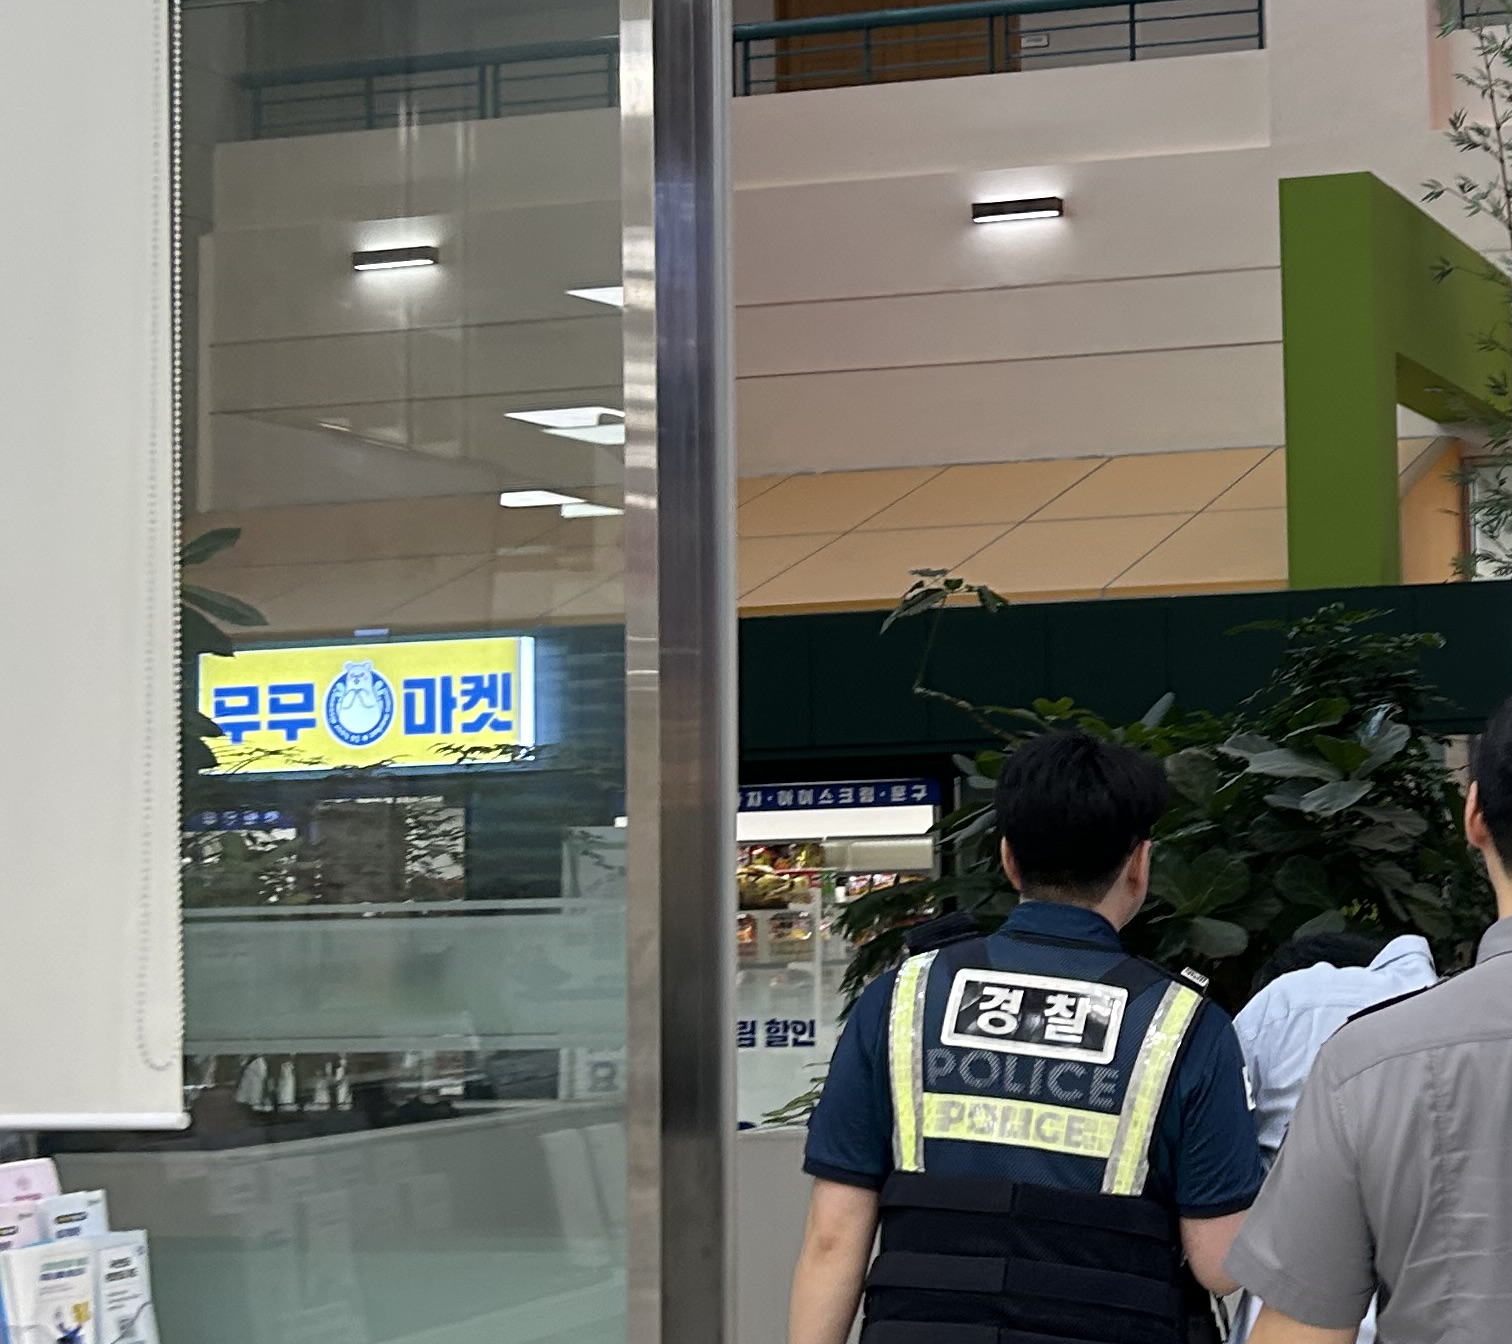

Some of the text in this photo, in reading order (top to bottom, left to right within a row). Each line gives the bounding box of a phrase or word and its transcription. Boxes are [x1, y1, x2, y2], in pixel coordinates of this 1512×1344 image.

[213, 682, 316, 744] 무무
[403, 672, 513, 735] 마켓
[764, 1017, 816, 1048] 할인
[976, 986, 1091, 1044] 경찰
[925, 1047, 1119, 1110] POLICE
[935, 1099, 1084, 1149] POLICE
